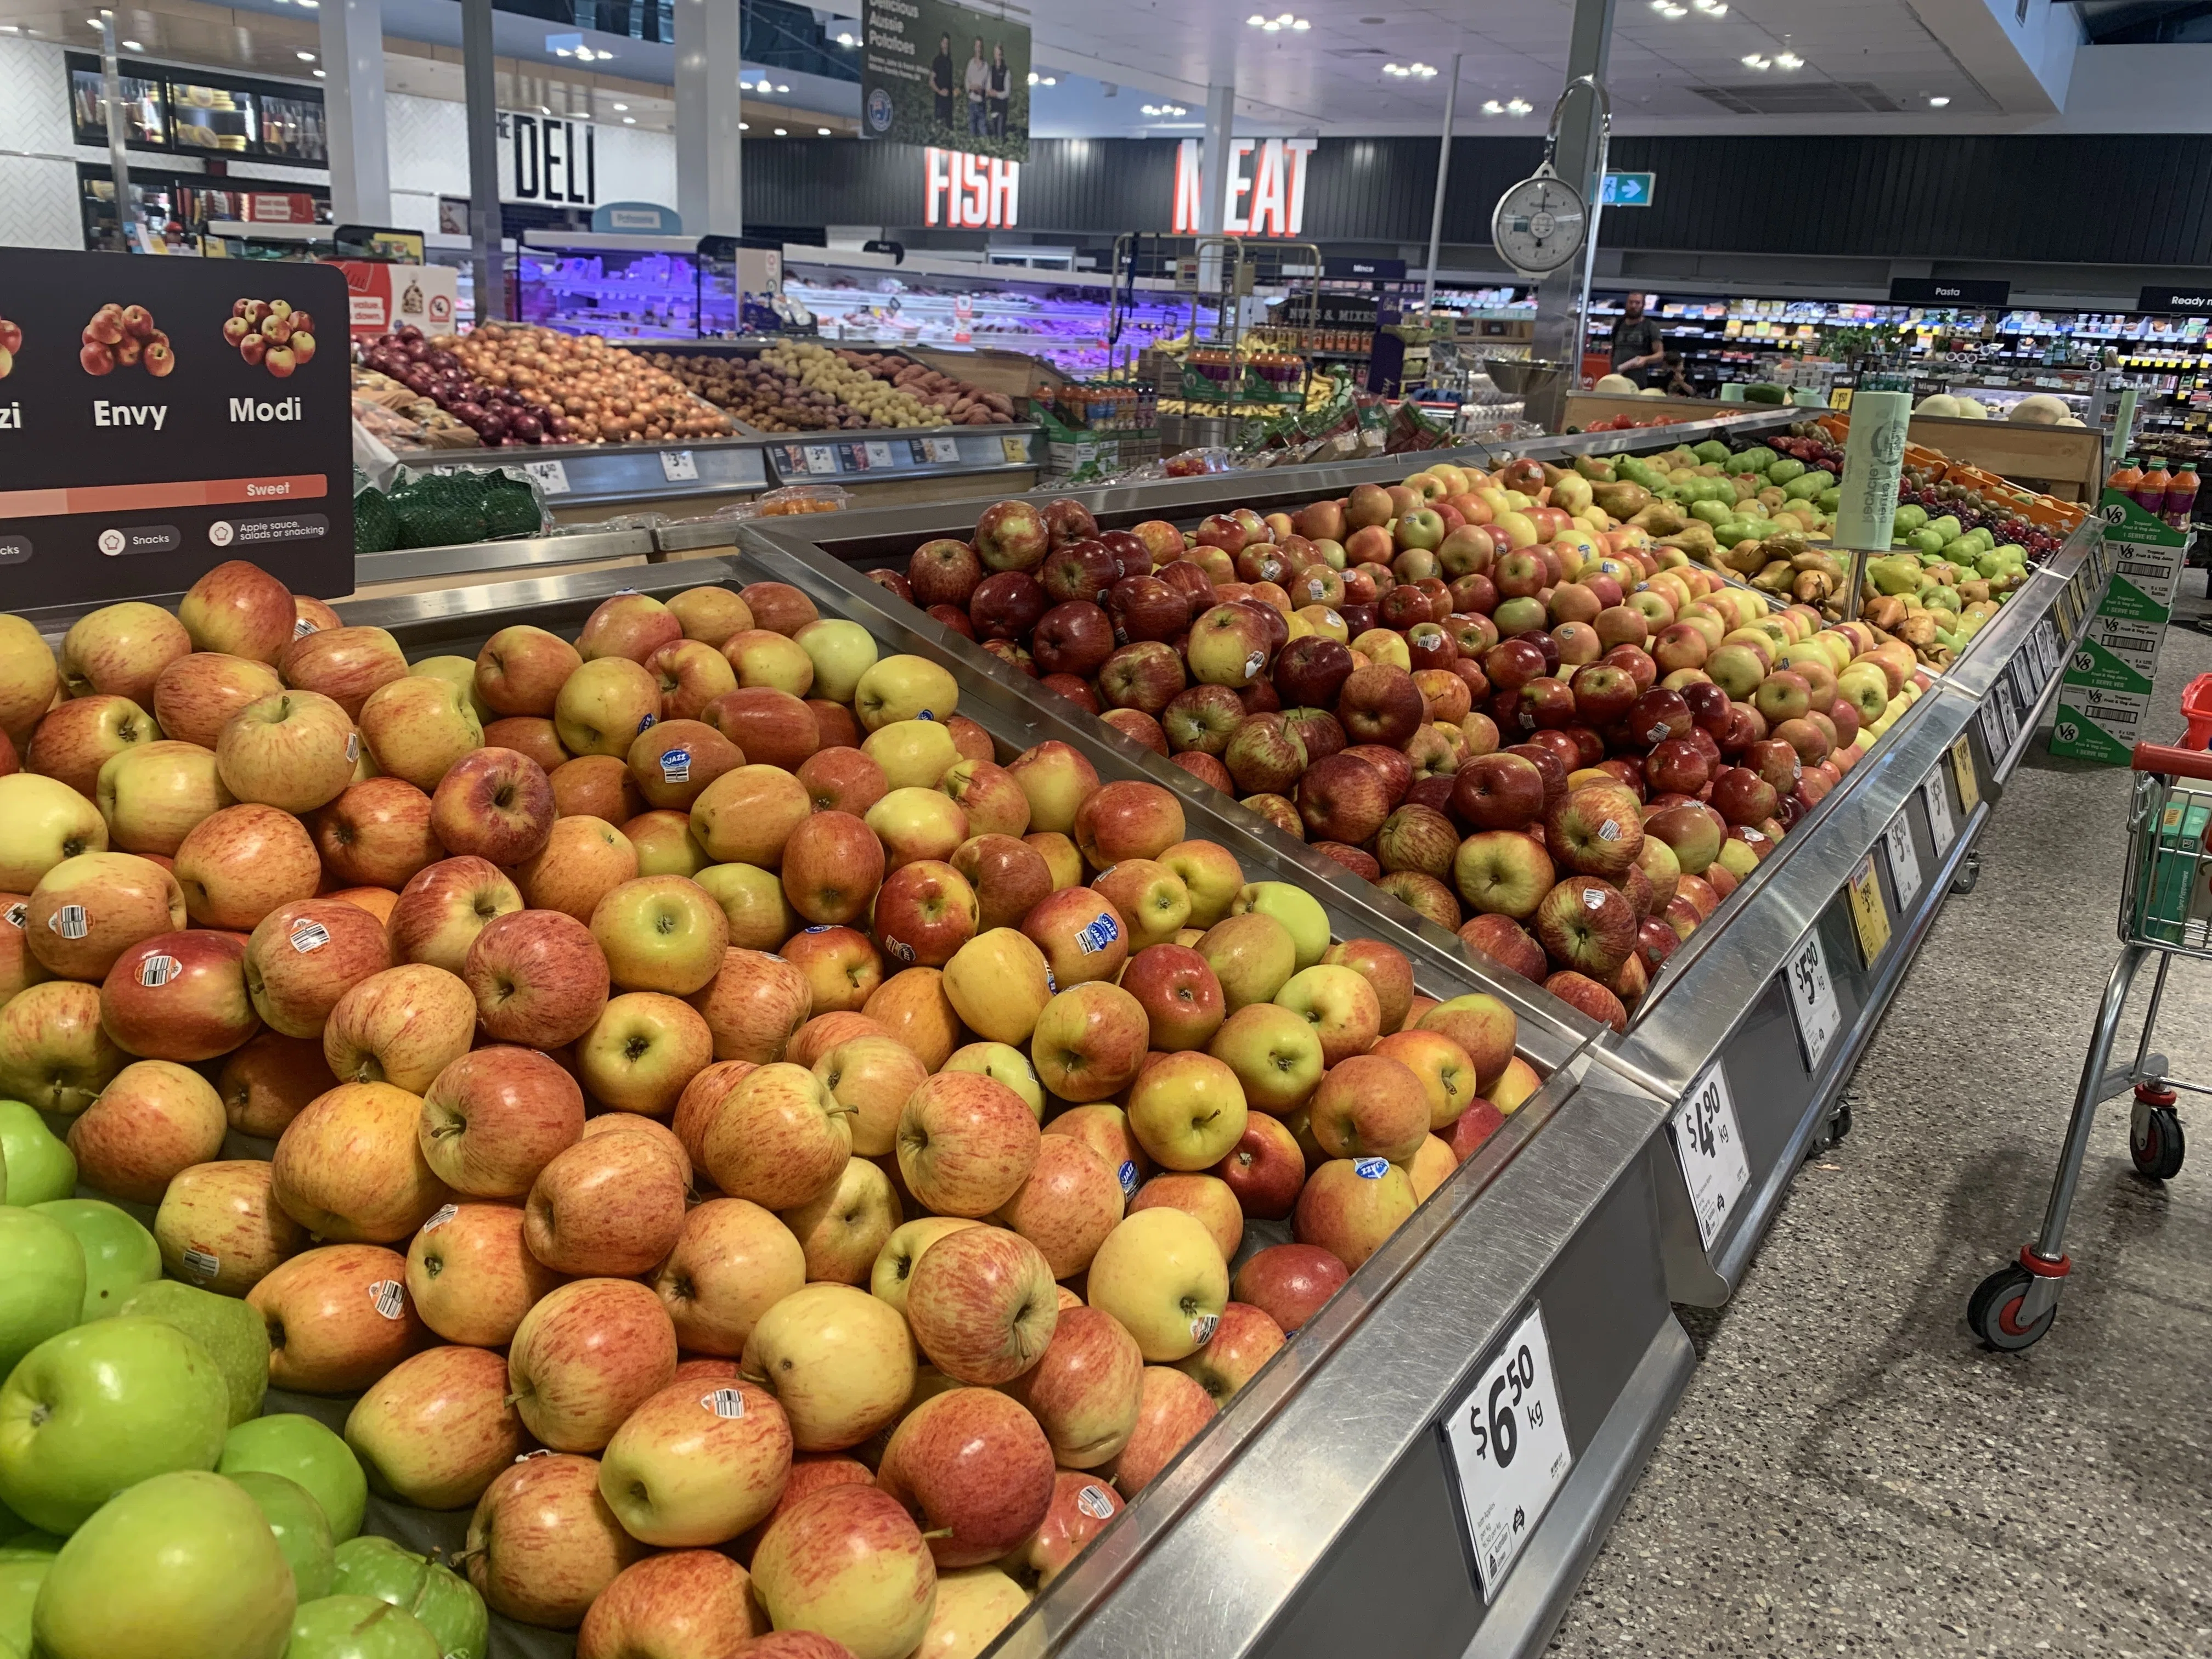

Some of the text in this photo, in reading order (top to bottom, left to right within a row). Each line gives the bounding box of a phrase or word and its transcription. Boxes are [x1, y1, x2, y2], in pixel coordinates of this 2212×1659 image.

[869, 11, 904, 33] Aussie
[869, 29, 915, 55] Potatoes
[514, 115, 595, 204] DELI
[924, 146, 1019, 229] FISH
[1936, 287, 1961, 296] Pasta
[2171, 296, 2205, 307] Ready
[1324, 309, 1334, 320] &
[1339, 309, 1378, 323] MIXES
[94, 400, 167, 430] Envy
[229, 397, 301, 422] Modi
[247, 482, 290, 496] Sweet
[2106, 506, 2123, 524] V8
[240, 522, 268, 532] Apple
[240, 526, 324, 540] salads or snacking
[133, 534, 170, 545] Snacks
[2120, 544, 2134, 558] V8
[2104, 618, 2119, 631] V8
[2075, 653, 2092, 670] V8
[2088, 689, 2103, 703] V8
[2059, 724, 2075, 741] V8
[668, 754, 686, 765] JAZZ
[2177, 870, 2189, 911] Pure Peppermint
[1102, 918, 1116, 937] JAZZ
[1091, 927, 1105, 946] JAZZ
[1816, 975, 1825, 991] kg
[1718, 1124, 1729, 1143] kg
[1122, 1163, 1136, 1184] JAZZ
[1361, 1161, 1384, 1175] JAZZ
[1527, 1400, 1543, 1430] kg
